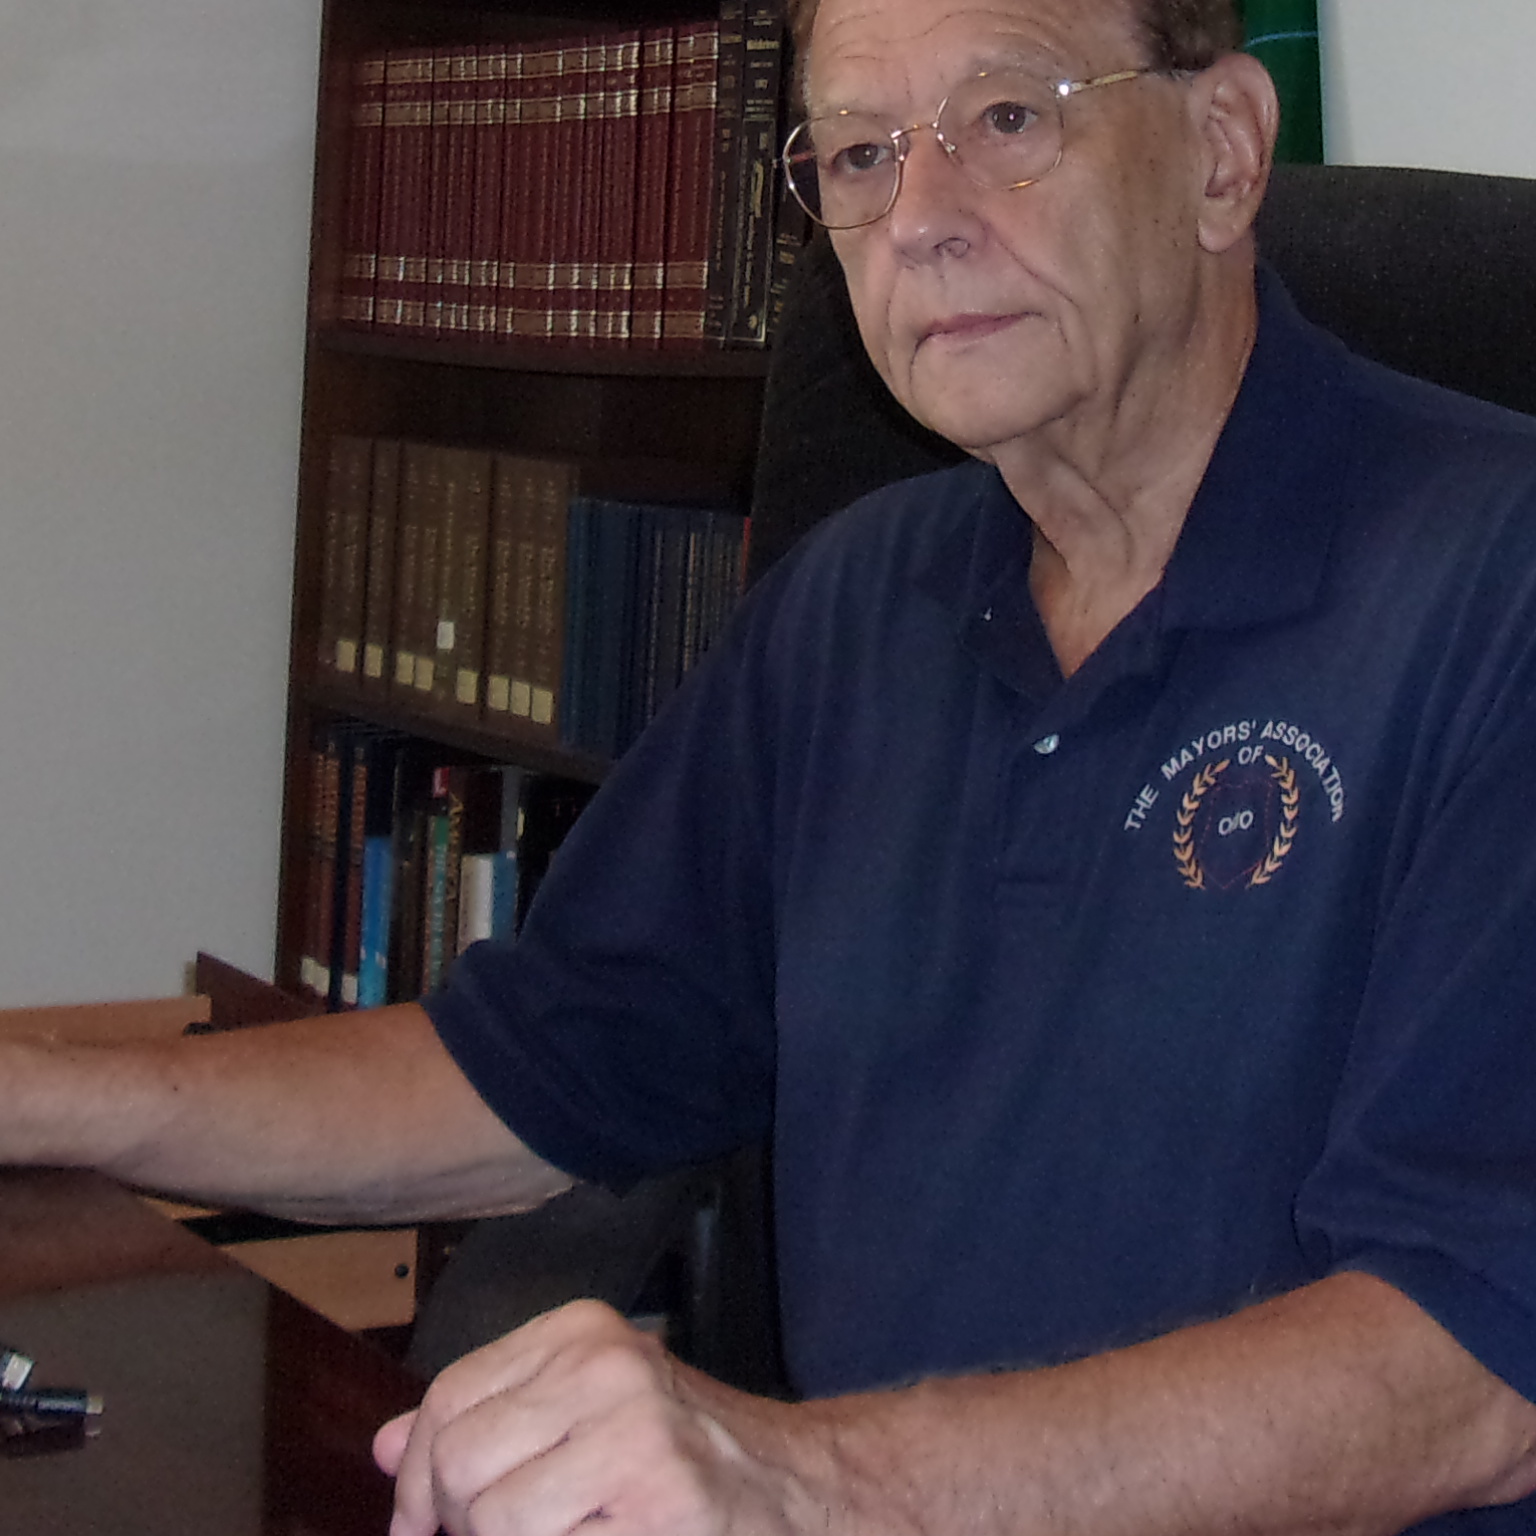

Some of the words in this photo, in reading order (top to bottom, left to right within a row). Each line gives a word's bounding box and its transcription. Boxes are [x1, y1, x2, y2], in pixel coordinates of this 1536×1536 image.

[1124, 784, 1159, 831] THE
[1260, 720, 1346, 823] ASSOCIATION
[1237, 745, 1264, 765] OF
